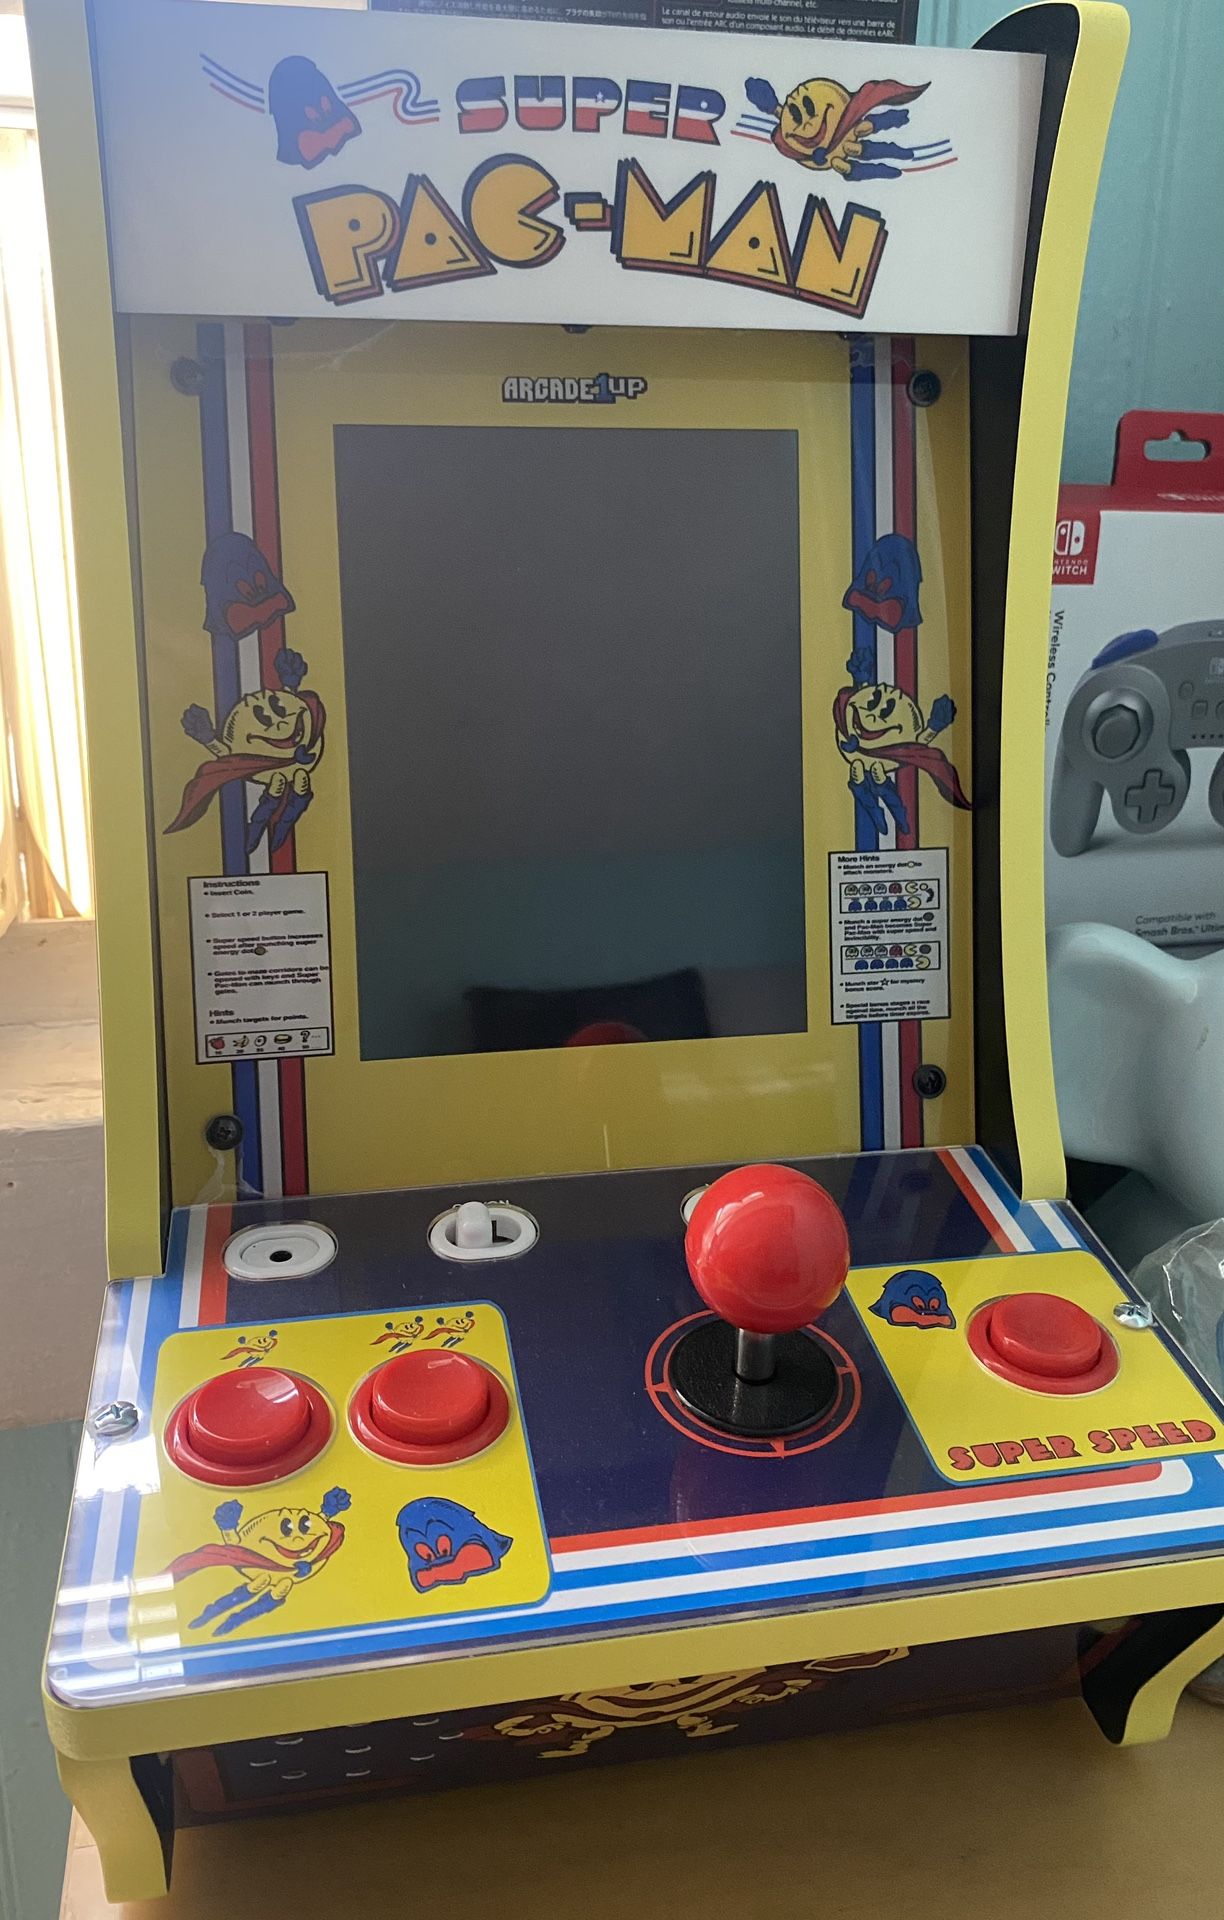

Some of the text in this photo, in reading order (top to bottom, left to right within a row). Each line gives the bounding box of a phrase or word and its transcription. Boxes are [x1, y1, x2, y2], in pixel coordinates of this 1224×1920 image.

[663, 7, 670, 15] Le
[672, 8, 690, 16] canal
[702, 10, 724, 18] retour
[746, 23, 784, 31] composant
[808, 25, 815, 33] Le
[836, 27, 845, 35] de
[456, 75, 726, 146] SUPER
[292, 153, 888, 320] PAC-MAN
[1052, 565, 1087, 575] WITCH
[1048, 610, 1065, 668] Wireless
[203, 879, 261, 889] Instructions
[1135, 912, 1216, 925] Compatible with
[1135, 927, 1168, 937] Smash
[948, 1419, 1216, 1470] SUPER SPEED
